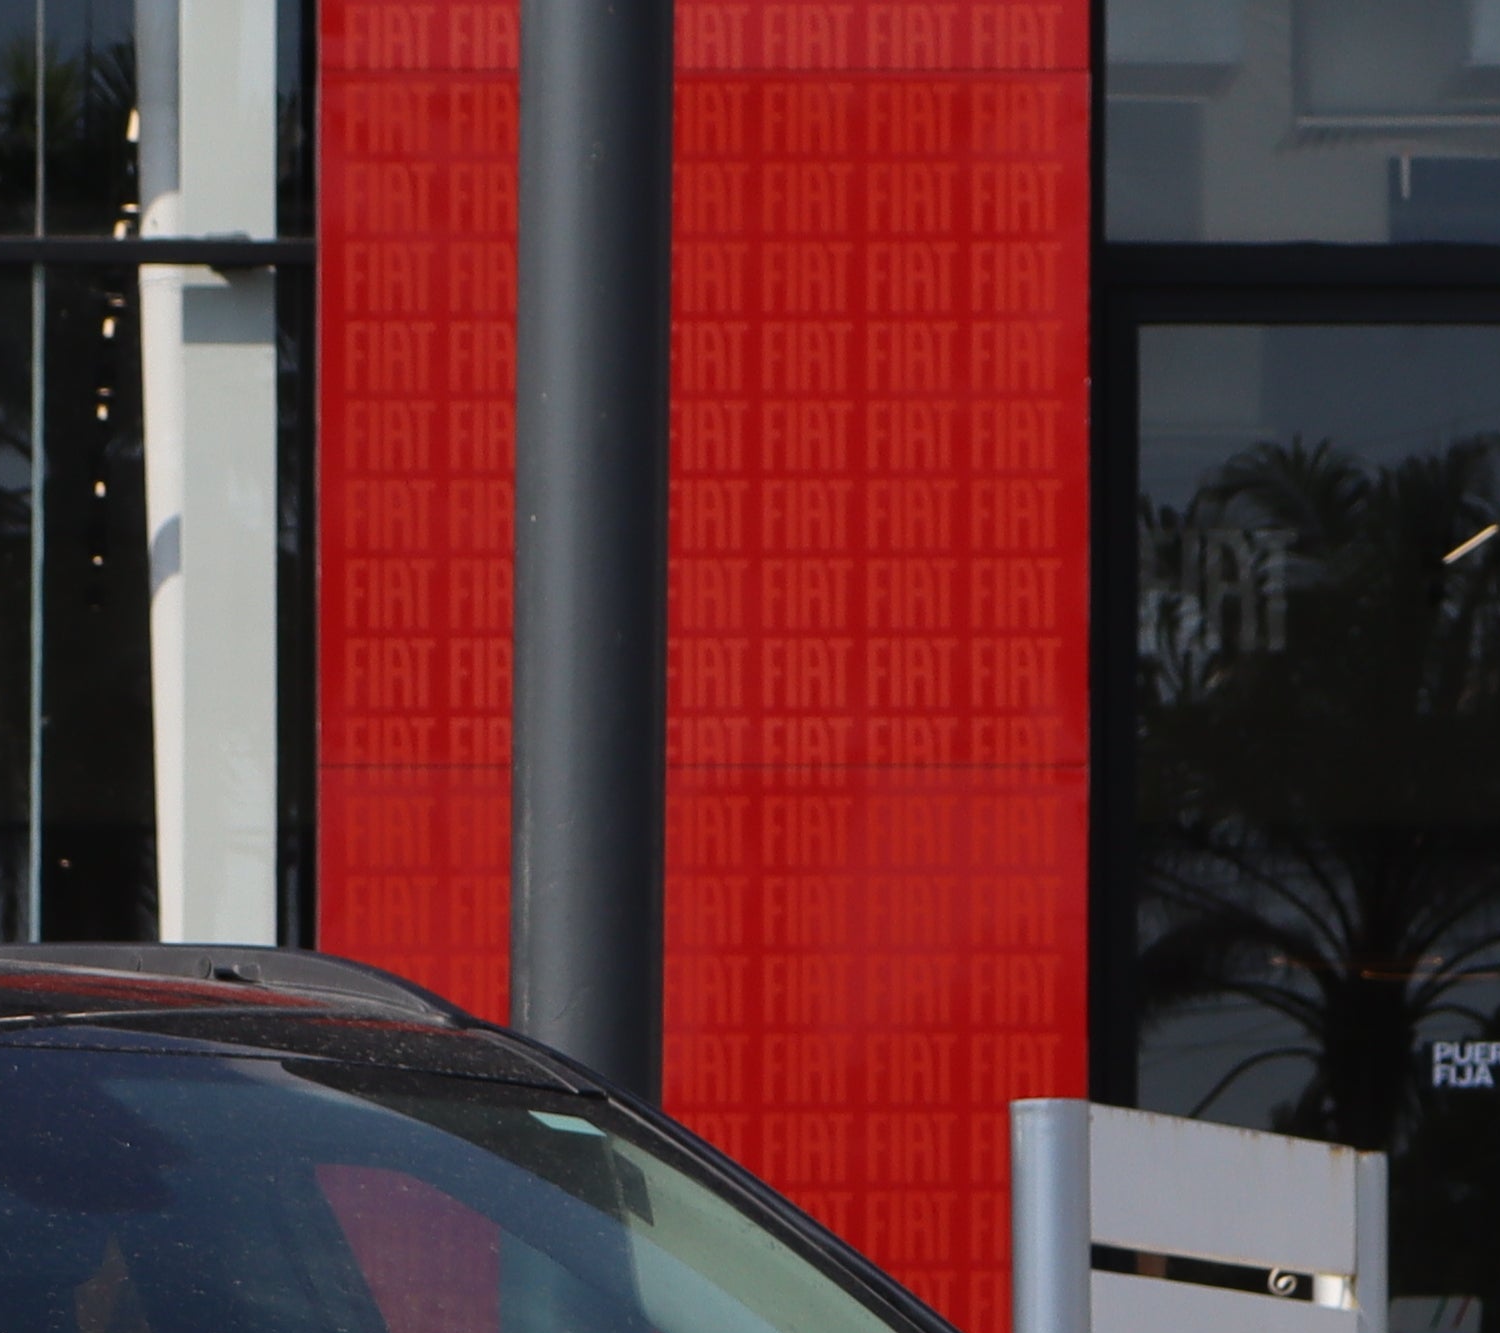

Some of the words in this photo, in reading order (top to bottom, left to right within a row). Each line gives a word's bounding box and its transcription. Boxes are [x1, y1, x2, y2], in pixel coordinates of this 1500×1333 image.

[345, 5, 436, 69] FIAT
[449, 5, 519, 69] FIA
[674, 5, 748, 69] IAT
[762, 5, 853, 69] FIAT
[866, 5, 958, 69] FIAT
[971, 5, 1062, 69] FIAT
[345, 83, 436, 152] FIAT
[449, 83, 518, 152] FIA
[673, 83, 748, 152] IAT
[762, 83, 853, 152] FIAT
[866, 83, 958, 152] FIAT
[971, 83, 1062, 152] FIAT
[345, 162, 436, 231] FIAT
[449, 162, 517, 231] FIA
[672, 162, 748, 231] IAT
[762, 162, 853, 231] FIAT
[866, 162, 958, 231] FIAT
[971, 162, 1062, 231] FIAT
[345, 242, 436, 310] FIAT
[449, 242, 516, 310] FIA
[671, 242, 748, 310] IAT
[762, 242, 853, 310] FIAT
[866, 242, 958, 310] FIAT
[971, 242, 1062, 310] FIAT
[345, 321, 436, 390] FIAT
[449, 321, 516, 390] FIA
[670, 321, 748, 390] IAT
[762, 321, 853, 390] FIAT
[866, 321, 958, 390] FIAT
[971, 321, 1062, 390] FIAT
[345, 400, 436, 469] FIAT
[449, 400, 515, 469] FIA
[762, 400, 853, 469] FIAT
[866, 400, 958, 469] FIAT
[971, 400, 1062, 469] FIAT
[345, 479, 436, 548] FIAT
[449, 479, 514, 548] FIA
[762, 479, 853, 548] FIAT
[866, 479, 958, 548] FIAT
[971, 479, 1062, 548] FIAT
[345, 558, 436, 628] FIAT
[449, 558, 513, 628] FIA
[762, 558, 853, 628] FIAT
[866, 558, 958, 628] FIAT
[971, 558, 1062, 628] FIAT
[345, 638, 436, 707] FIAT
[449, 638, 513, 707] FIA
[762, 638, 853, 707] FIAT
[866, 638, 958, 707] FIAT
[971, 638, 1062, 707] FIAT
[345, 717, 436, 786] FIAT
[449, 717, 512, 786] FIA
[762, 717, 853, 786] FIAT
[866, 717, 958, 786] FIAT
[971, 717, 1062, 786] FIAT
[345, 796, 436, 865] FIAT
[449, 796, 511, 865] FIA
[762, 796, 853, 865] FIAT
[866, 796, 958, 865] FIAT
[971, 796, 1062, 865] FIAT
[345, 876, 436, 944] FIAT
[449, 876, 510, 944] FIA
[762, 876, 853, 944] FIAT
[866, 876, 958, 944] FIAT
[971, 876, 1062, 944] FIAT
[449, 955, 510, 1024] FIA
[762, 955, 853, 1024] FIAT
[866, 955, 958, 1024] FIAT
[971, 955, 1062, 1024] FIAT
[762, 1034, 853, 1103] FIAT
[866, 1034, 958, 1103] FIAT
[971, 1034, 1062, 1103] FIAT
[1432, 1065, 1494, 1087] FIJA
[762, 1113, 853, 1182] FIAT
[866, 1113, 958, 1182] FIAT
[866, 1192, 958, 1262] FIAT
